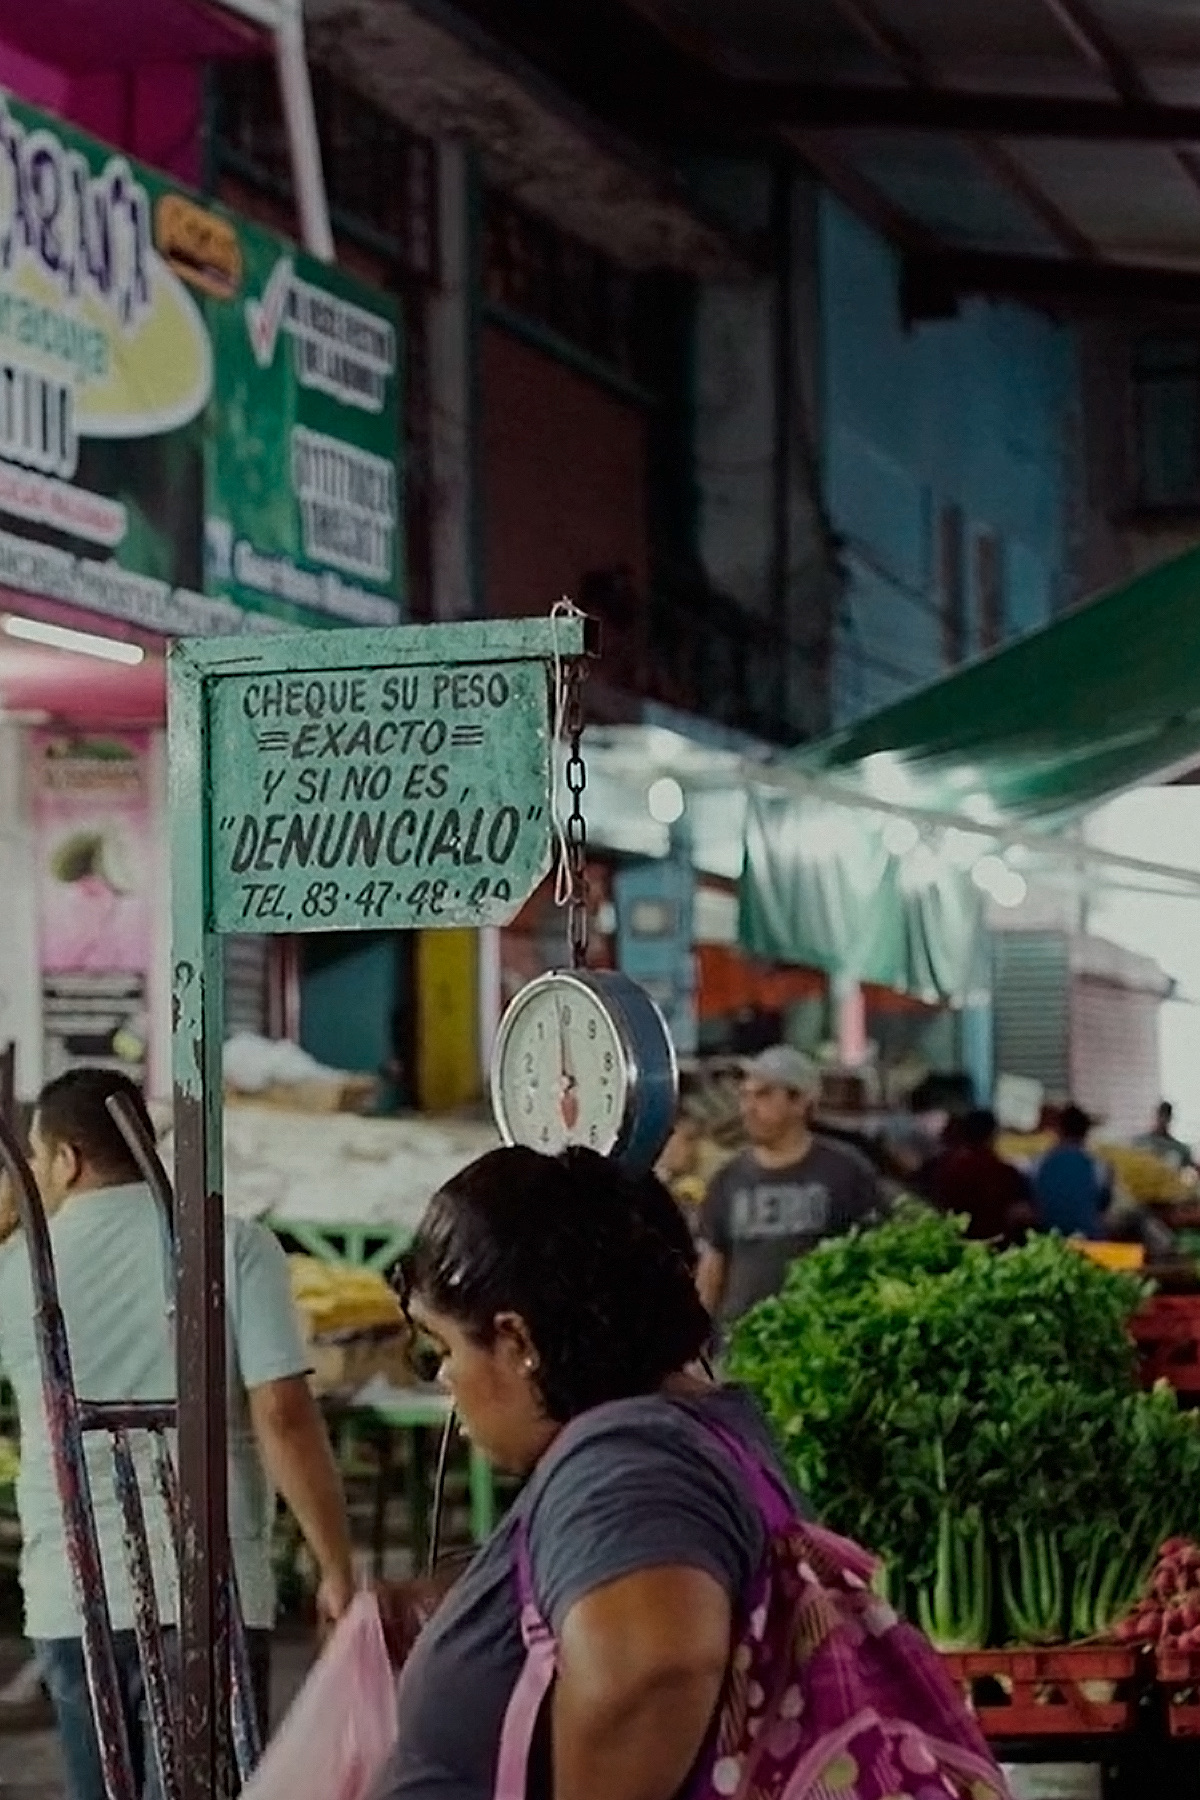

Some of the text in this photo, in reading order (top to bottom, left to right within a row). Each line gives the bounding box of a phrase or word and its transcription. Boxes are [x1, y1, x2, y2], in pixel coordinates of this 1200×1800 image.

[243, 673, 510, 719] CHEQUE SU PESO
[291, 719, 448, 759] EXACTO
[262, 769, 287, 805] Y
[295, 767, 331, 804] SI
[340, 765, 392, 802] NO
